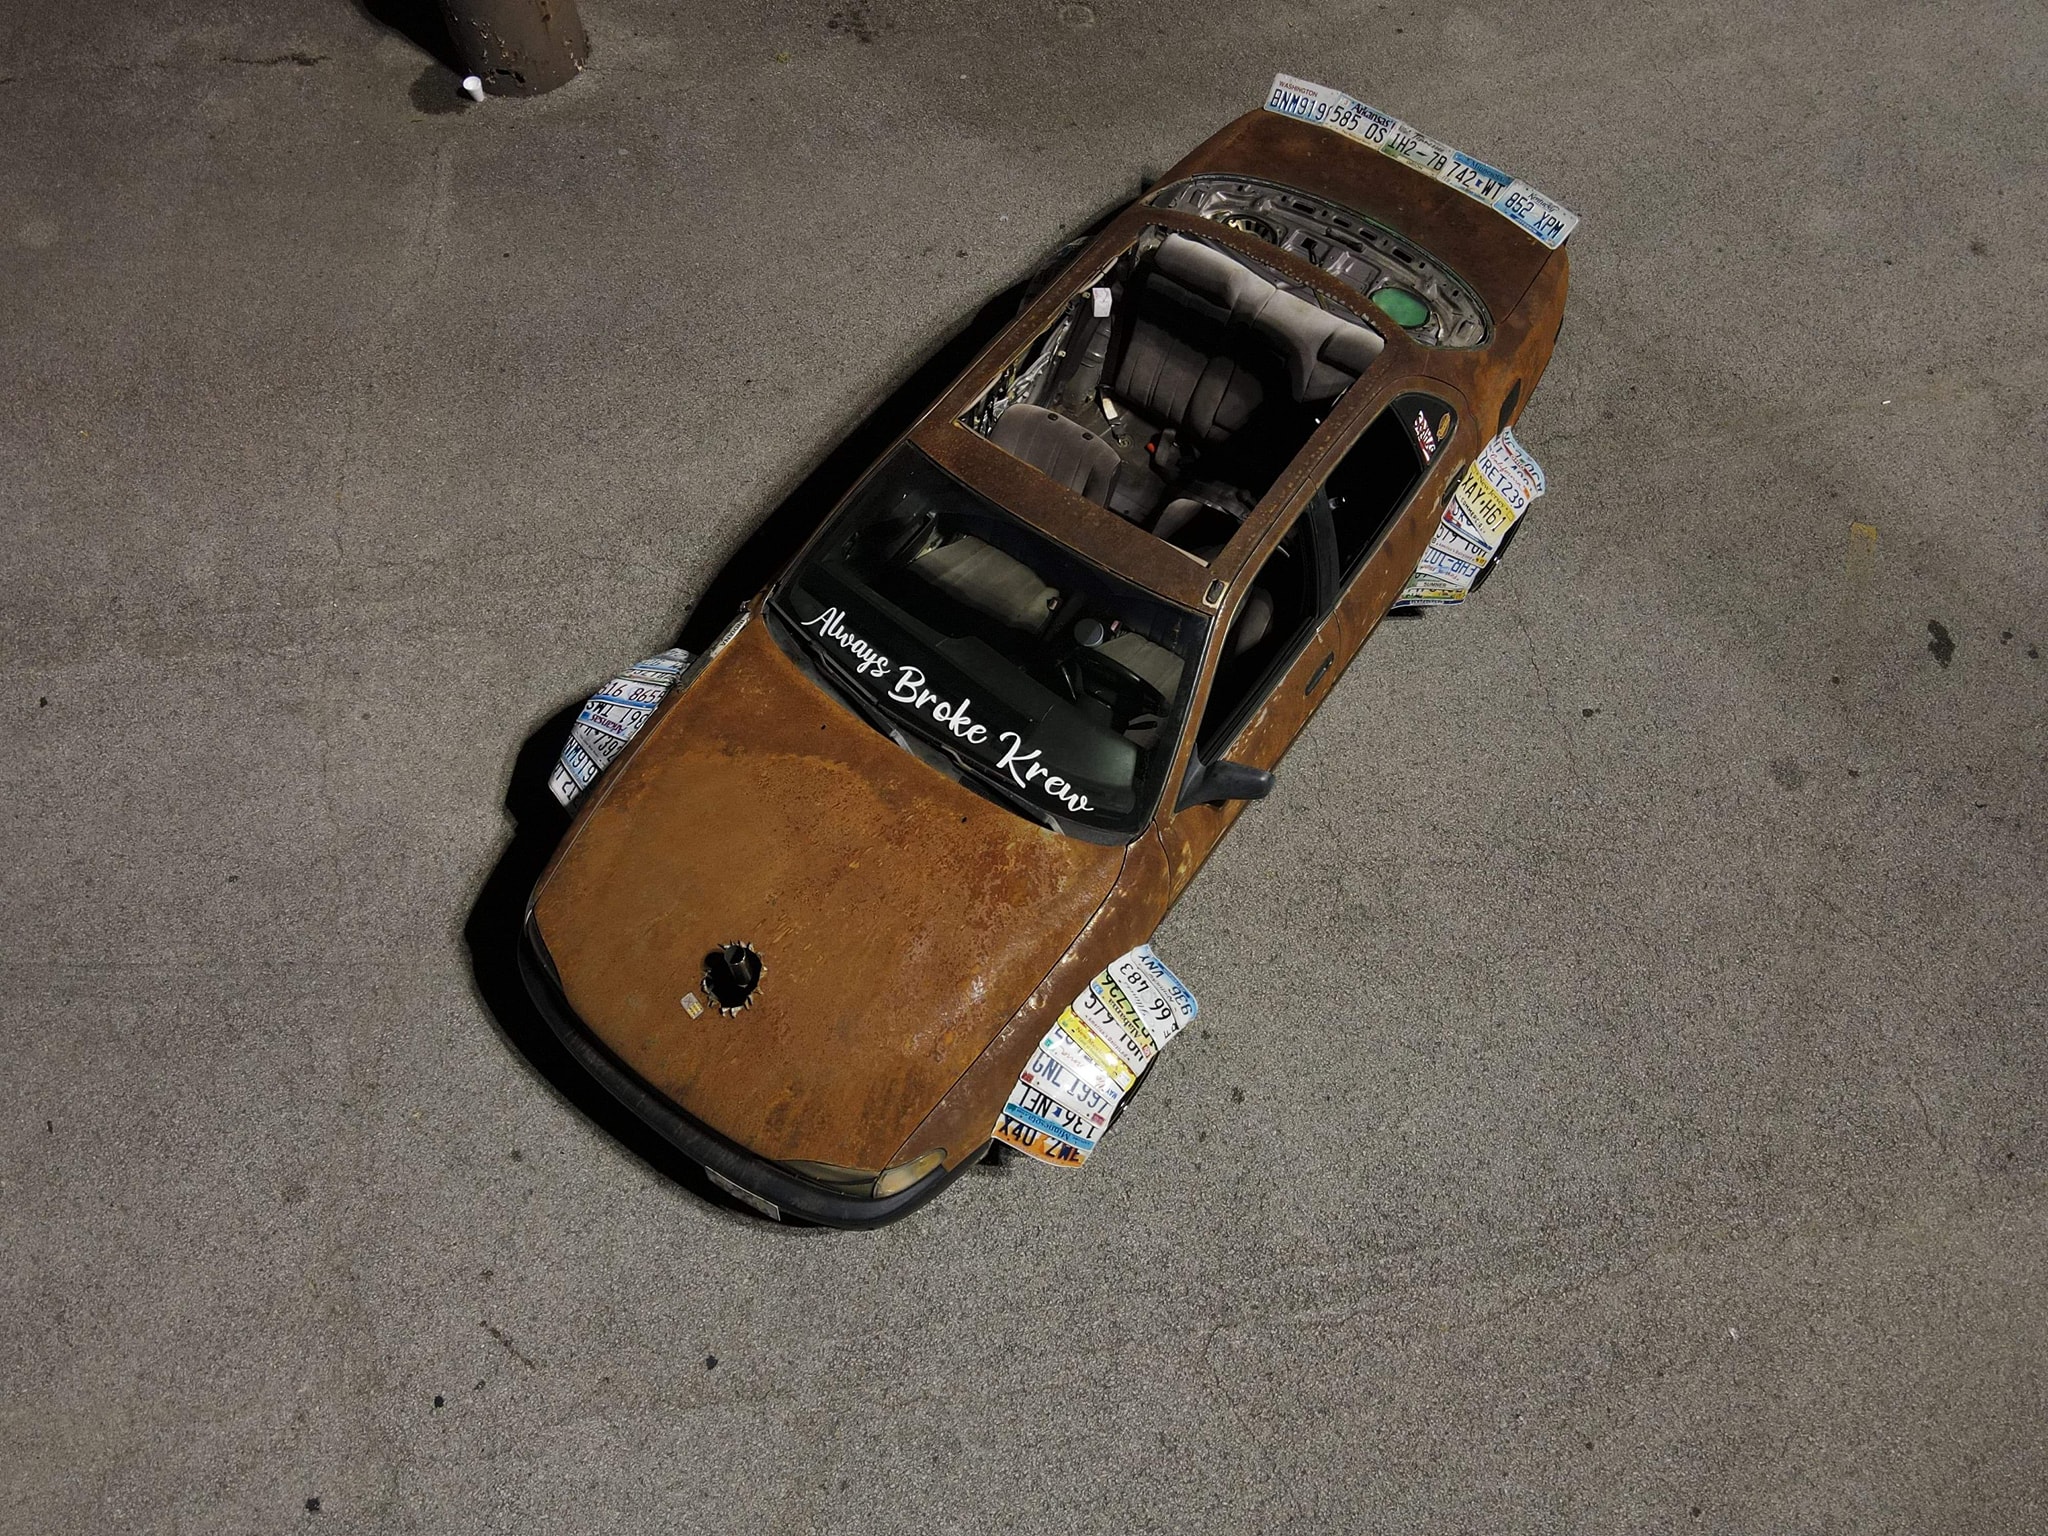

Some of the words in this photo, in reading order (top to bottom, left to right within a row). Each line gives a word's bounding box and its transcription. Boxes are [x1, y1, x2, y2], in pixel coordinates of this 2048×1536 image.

[1269, 88, 1333, 122] BNM919
[1279, 81, 1319, 98] WASHINGTON
[1330, 106, 1362, 131] 585
[1351, 103, 1390, 127] Arkansas
[1504, 192, 1535, 219] 852
[1534, 211, 1565, 240] XPM
[1528, 192, 1560, 213] Kentucky
[1489, 451, 1522, 489] California
[1478, 474, 1490, 489] New
[1488, 487, 1507, 510] Jersey
[1459, 496, 1485, 534] COMMERCIAL
[801, 606, 890, 678] Always
[888, 665, 988, 745] Broke
[996, 731, 1095, 812] Krew
[1108, 997, 1143, 1039] Alabama
